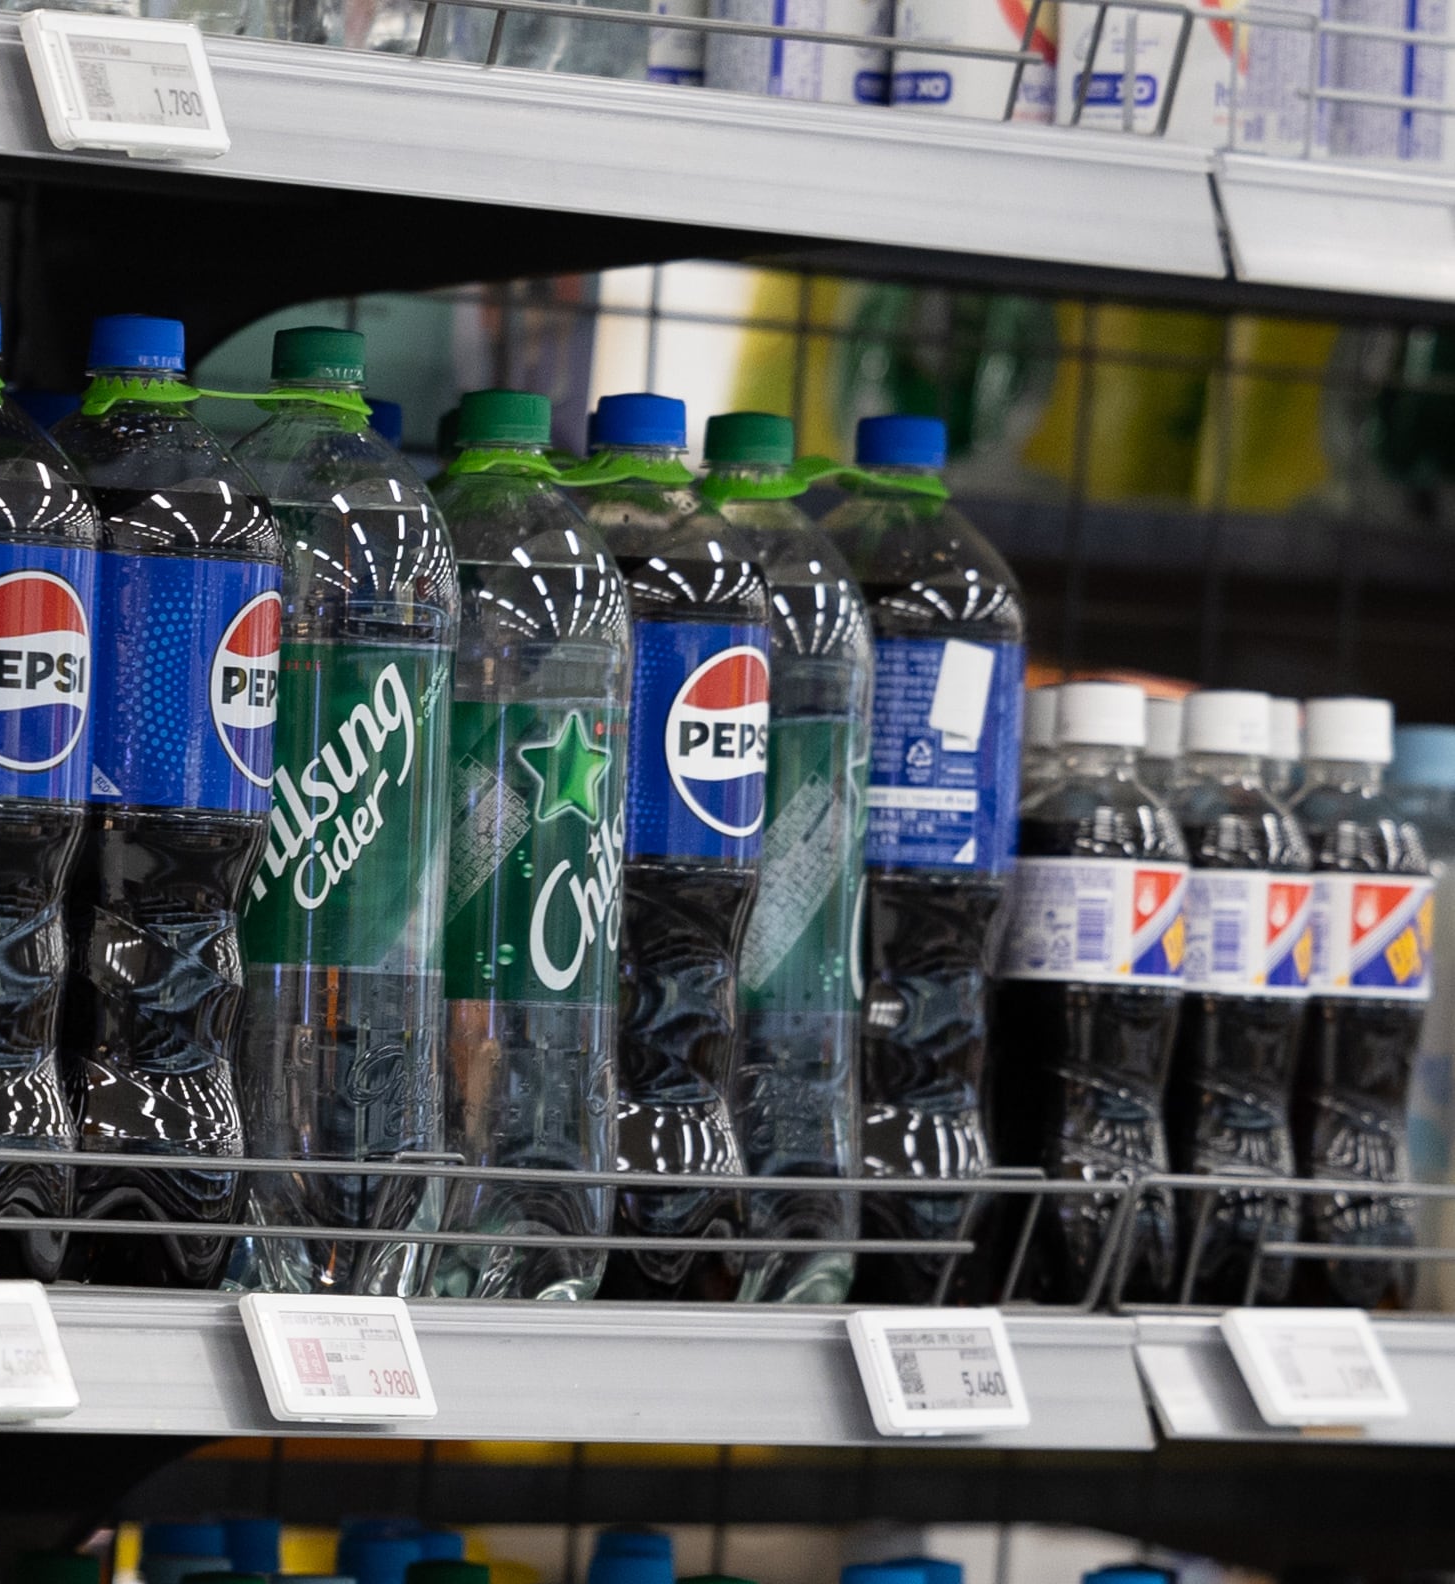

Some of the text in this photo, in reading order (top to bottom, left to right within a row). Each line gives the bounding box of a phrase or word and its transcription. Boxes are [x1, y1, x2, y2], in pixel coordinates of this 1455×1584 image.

[251, 662, 415, 902] ilsung
[679, 720, 767, 761] PEPS
[293, 768, 389, 910] Cider
[368, 1369, 415, 1396] 3,980
